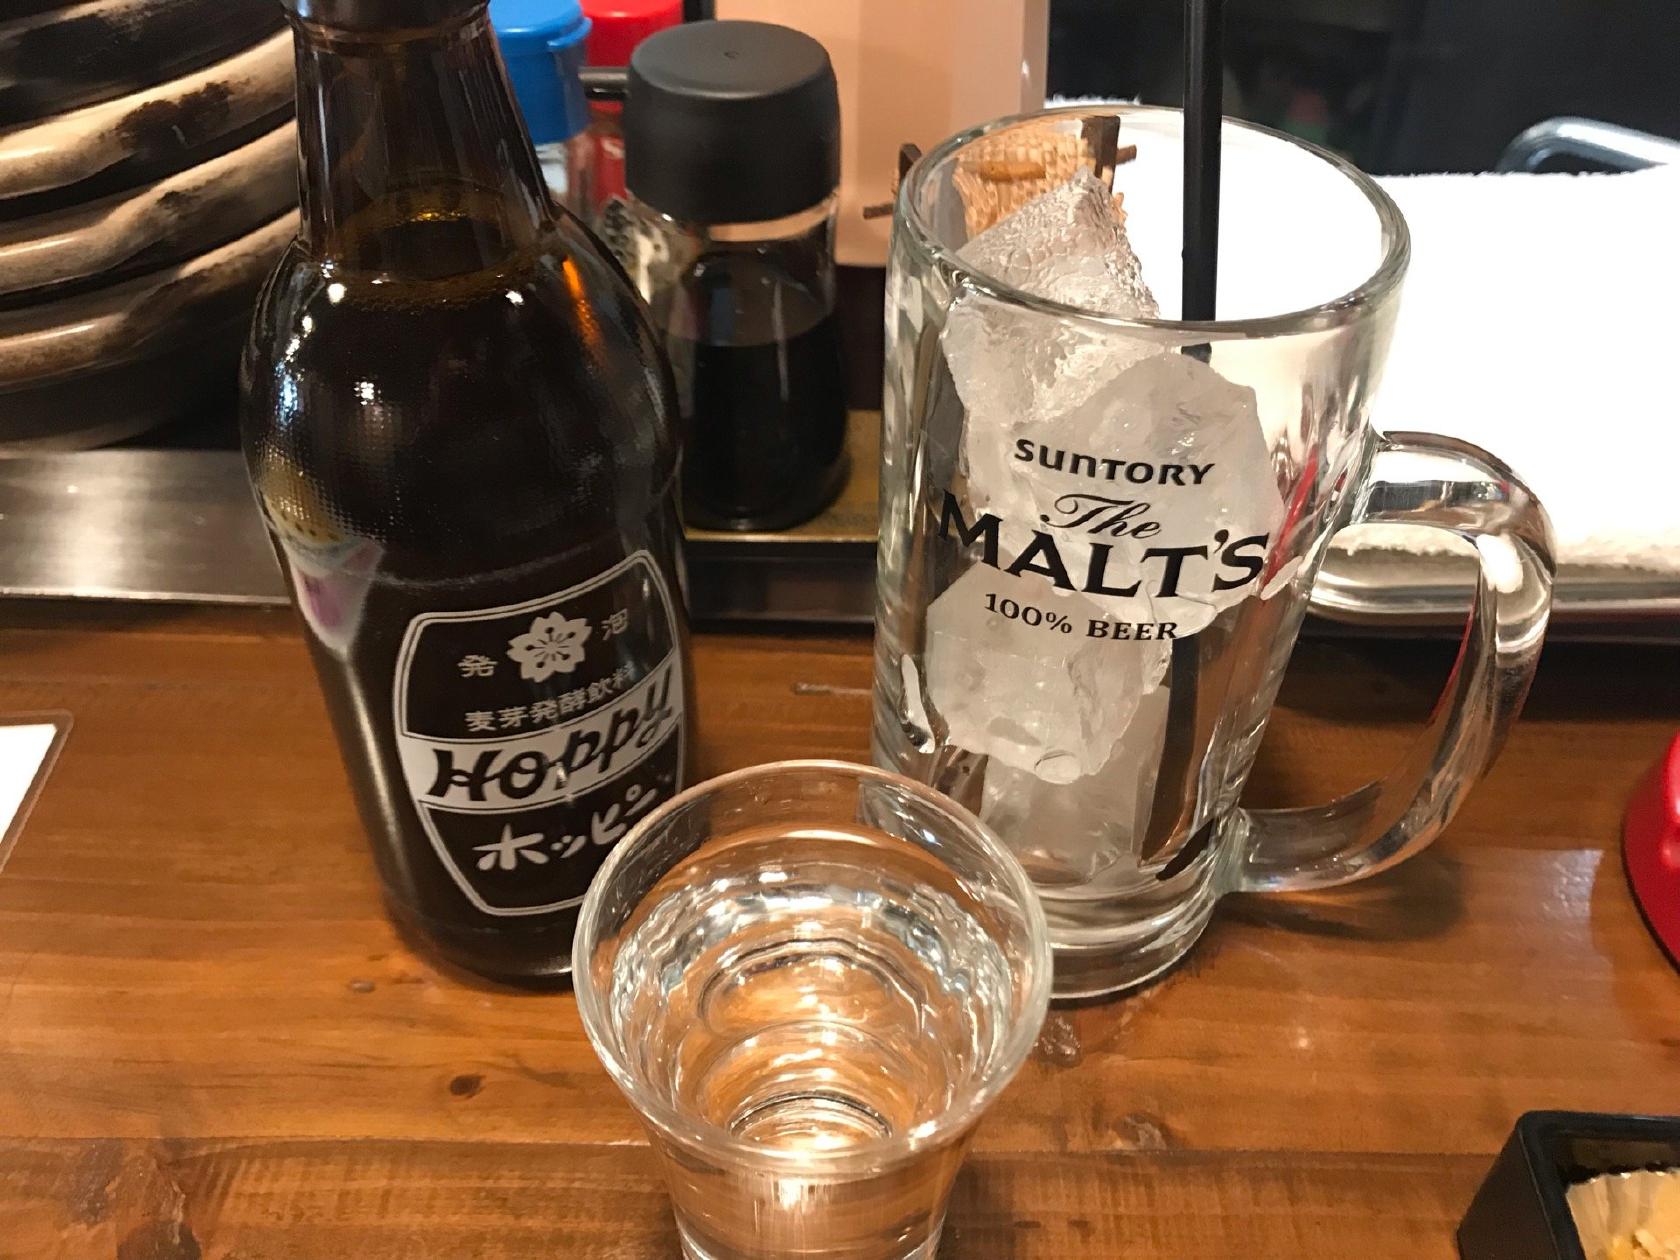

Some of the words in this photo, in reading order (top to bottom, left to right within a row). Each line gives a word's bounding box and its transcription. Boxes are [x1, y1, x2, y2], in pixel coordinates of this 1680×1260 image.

[1014, 438, 1216, 487] SUNTORY
[1040, 493, 1162, 539] The
[938, 489, 1270, 599] MALT'S
[984, 593, 1073, 635] 100%
[1086, 619, 1178, 641] BEER
[457, 654, 498, 678] 発
[472, 784, 658, 871] ホッピー
